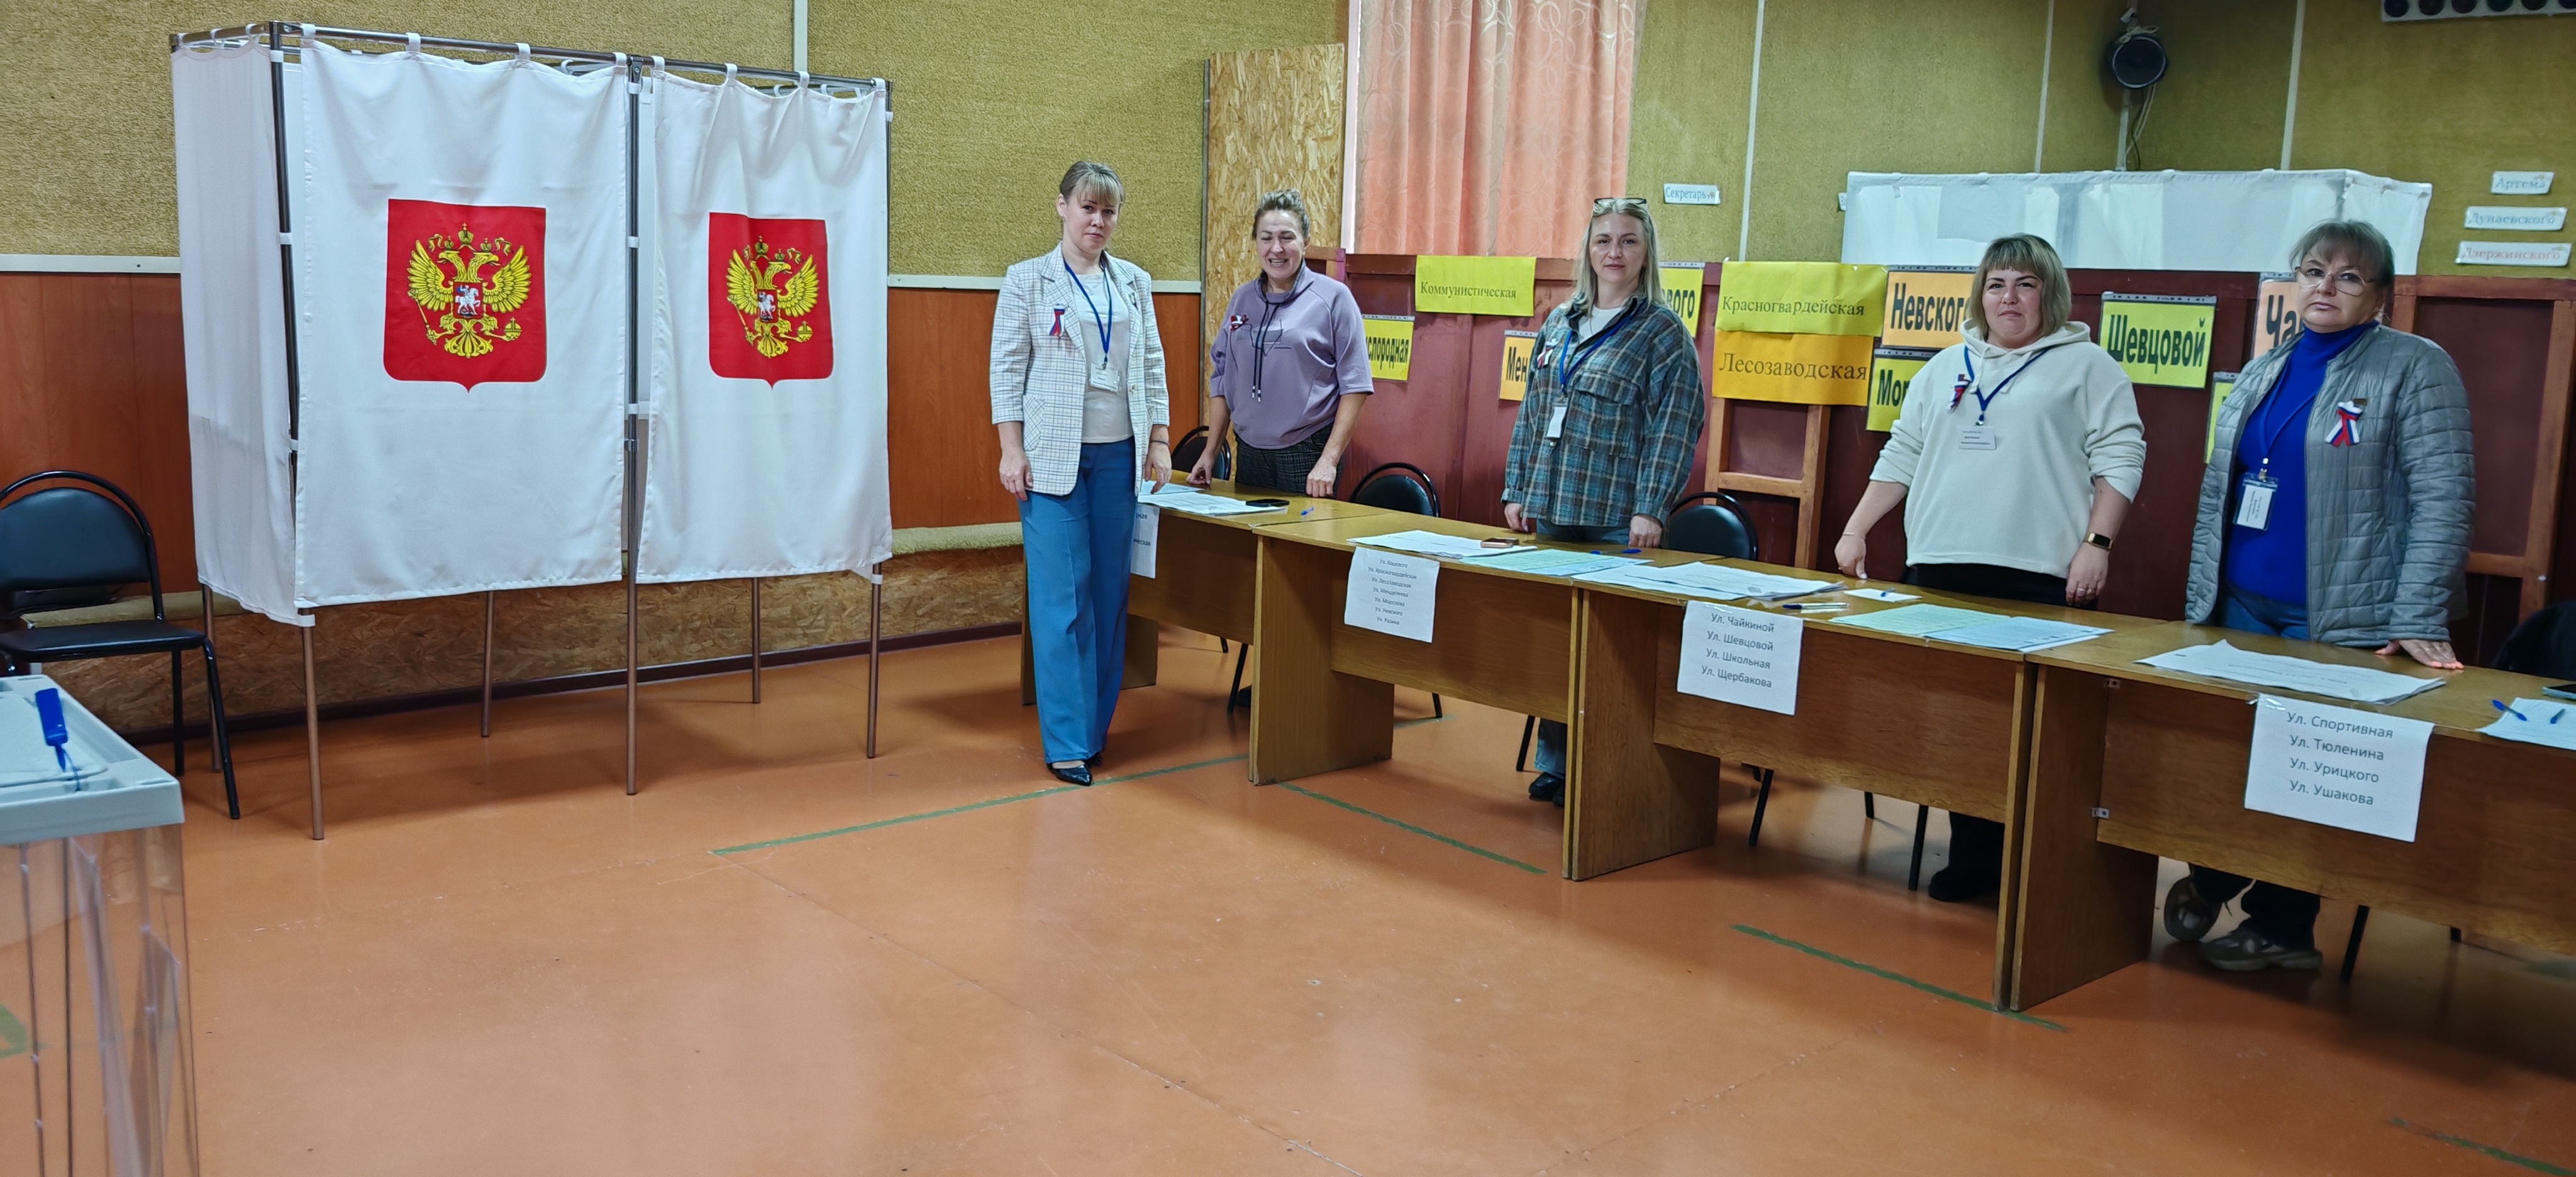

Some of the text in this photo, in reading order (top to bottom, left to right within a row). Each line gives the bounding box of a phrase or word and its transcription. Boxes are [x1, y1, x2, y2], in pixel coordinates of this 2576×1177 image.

[1665, 187, 1706, 201] Секретарь
[2468, 213, 2556, 225] Дунаевского
[2462, 247, 2560, 261] Дзержинского
[1420, 282, 1516, 299] Коммунистическая
[1722, 296, 1865, 316] Красногвардейская
[2266, 295, 2303, 348] Ча
[2107, 314, 2206, 374] Шевцовой
[1506, 346, 1528, 382] Мен
[1719, 353, 1868, 380] Лесозаводская
[1711, 613, 1774, 633] Ул. Чайкиной
[1707, 630, 1774, 651] Ул. Шевцовой
[1706, 648, 1770, 670] Ул. Школьная
[1701, 665, 1772, 688] Ул. Щербакова
[2287, 711, 2394, 739] Ул. Спортивная
[2290, 734, 2384, 761] Ул. Тюленина
[2290, 757, 2379, 783] Ул. Урицкого
[2290, 780, 2373, 805] Ул. Ушакова
